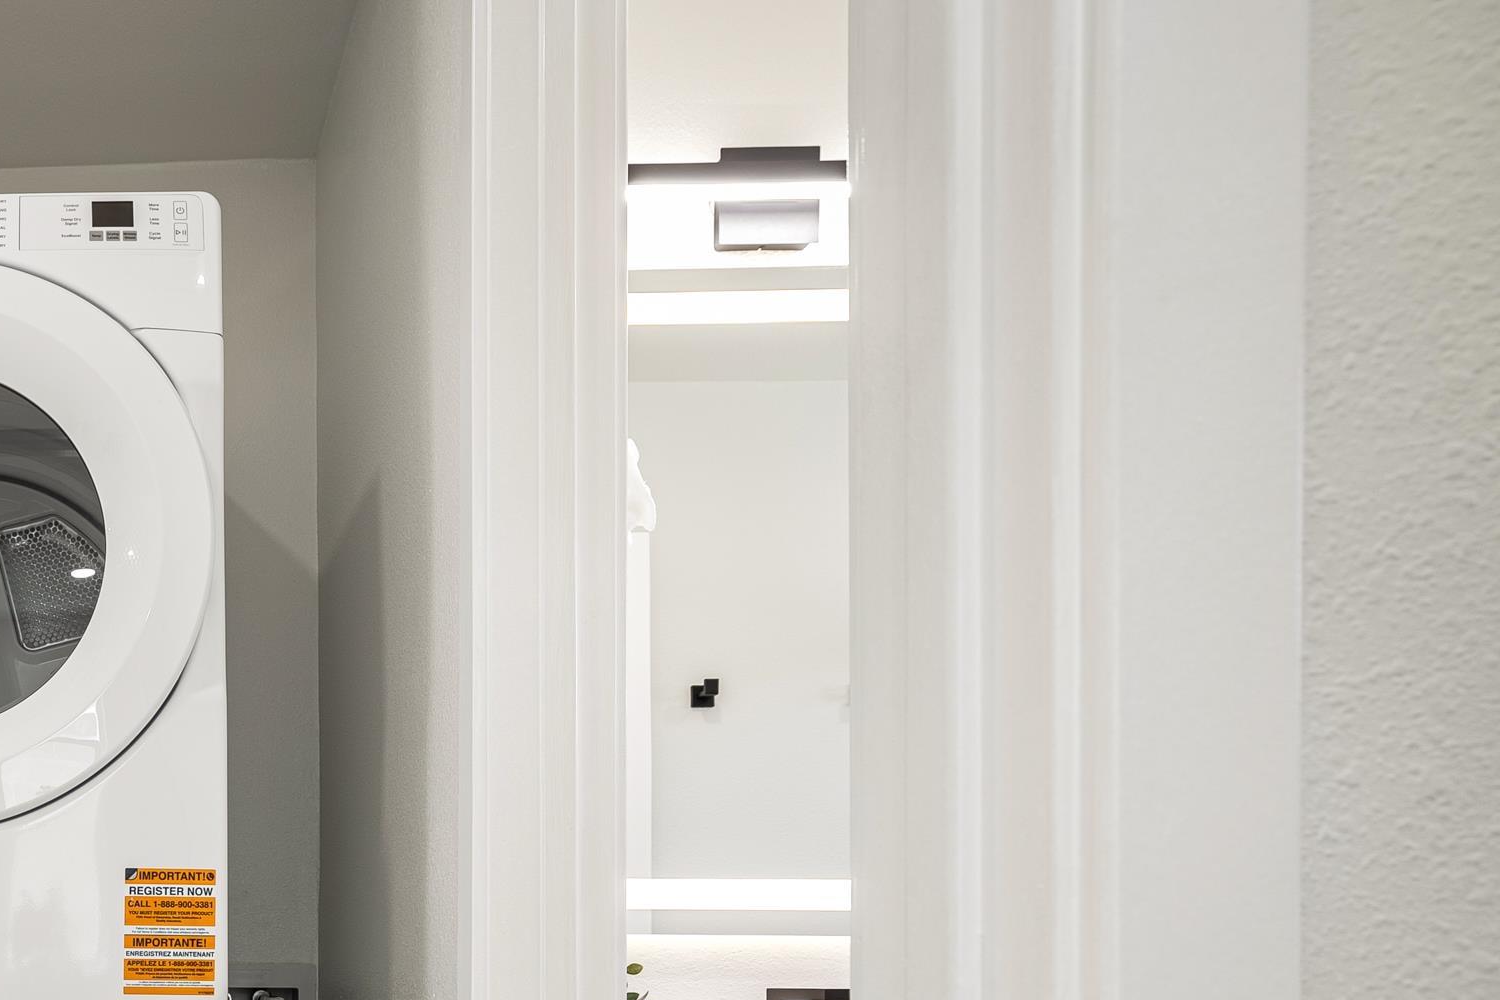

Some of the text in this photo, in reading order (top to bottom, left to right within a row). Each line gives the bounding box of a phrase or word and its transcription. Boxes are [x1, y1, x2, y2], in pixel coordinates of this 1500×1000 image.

[139, 871, 206, 881] IMPORTANT!
[129, 886, 213, 896] REGISTER NOW
[132, 938, 207, 948] IMPORTANTE!
